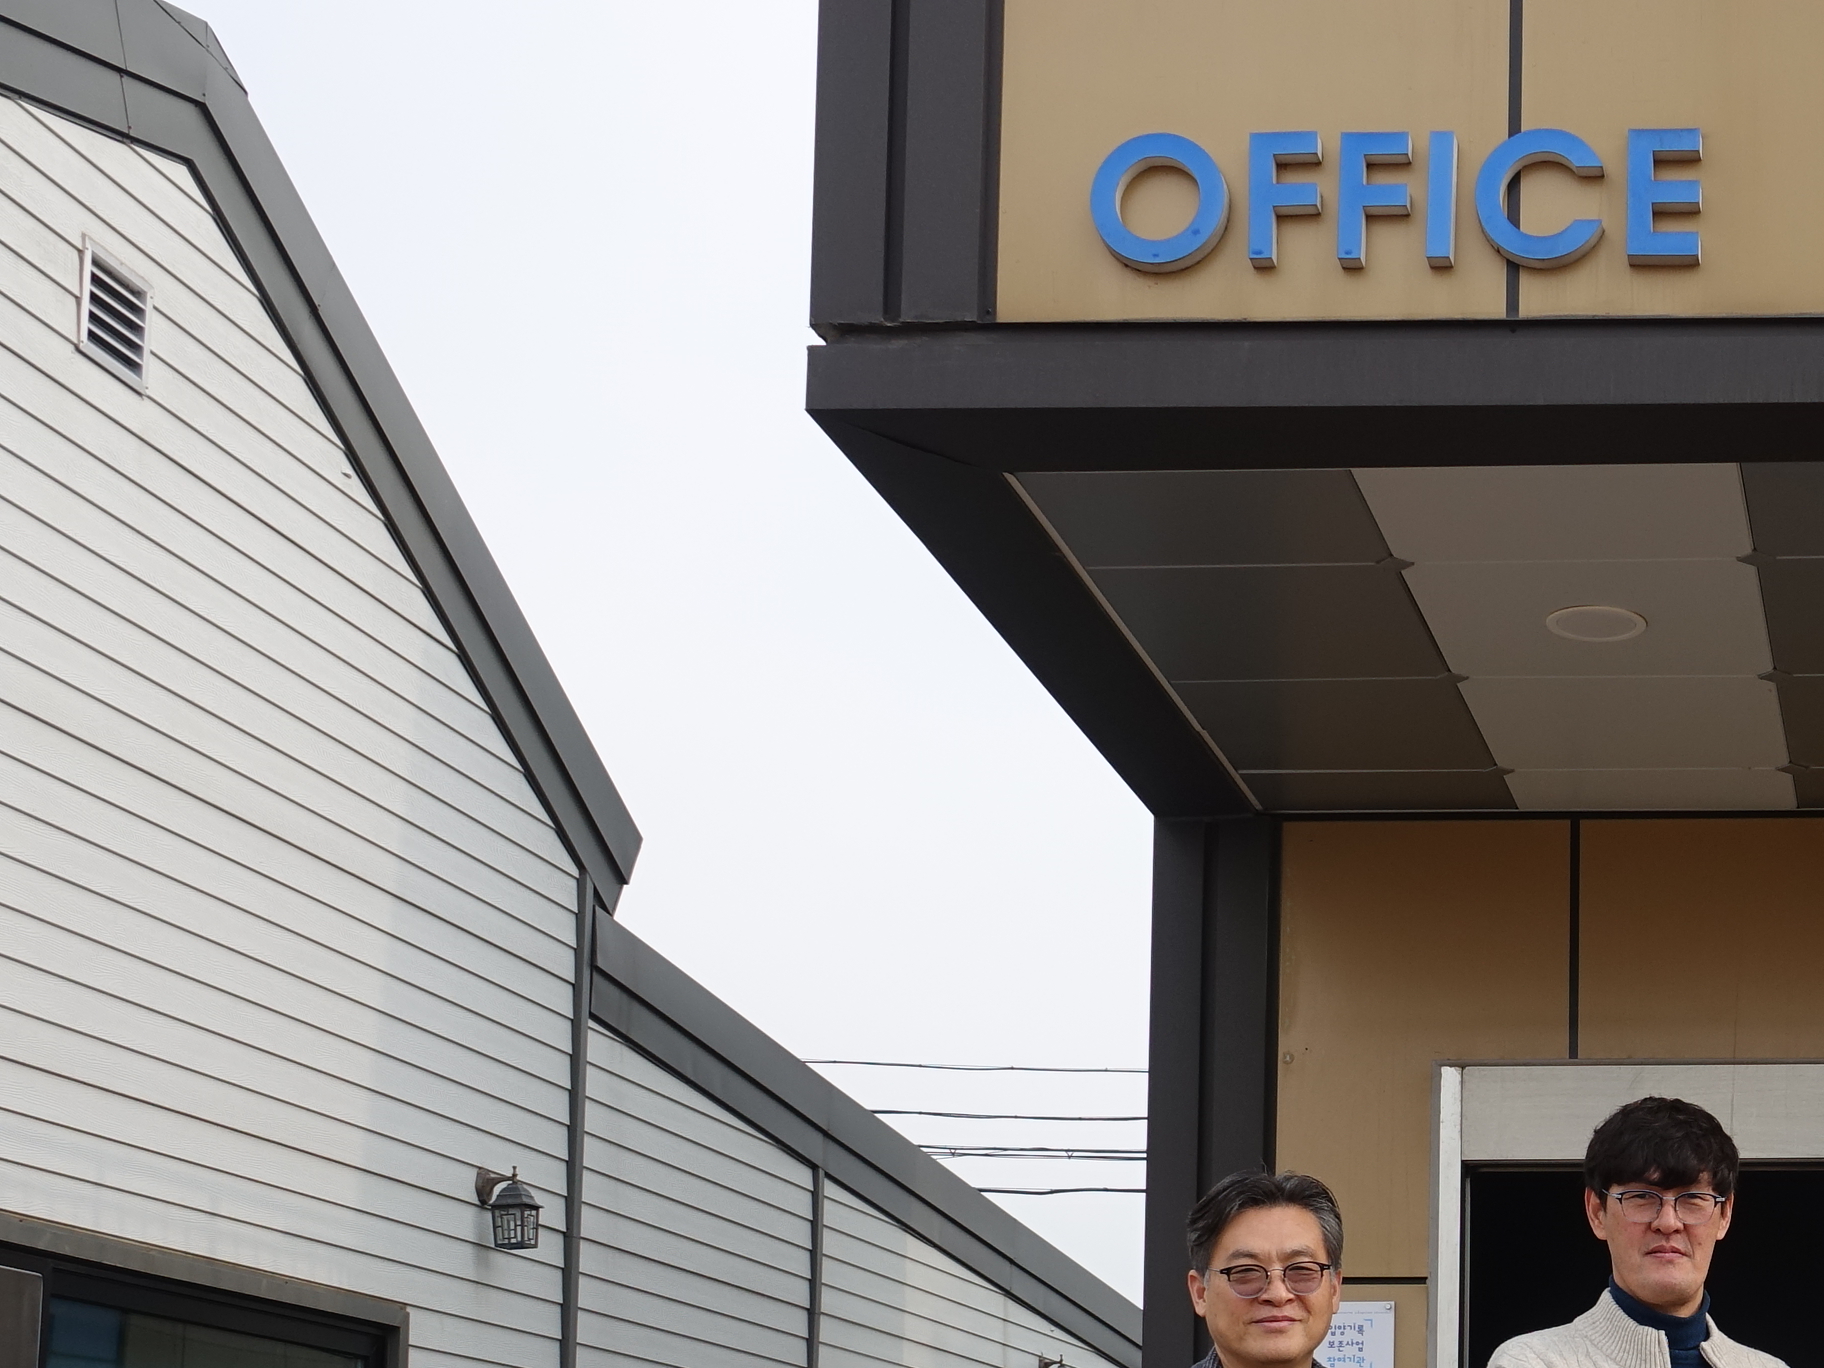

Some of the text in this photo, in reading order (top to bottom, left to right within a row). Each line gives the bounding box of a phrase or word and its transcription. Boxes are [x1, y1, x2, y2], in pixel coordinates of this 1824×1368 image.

[1090, 128, 1703, 273] OFFICE
[1328, 1339, 1365, 1352] 보존사업
[1326, 1354, 1366, 1368] 참여기관
